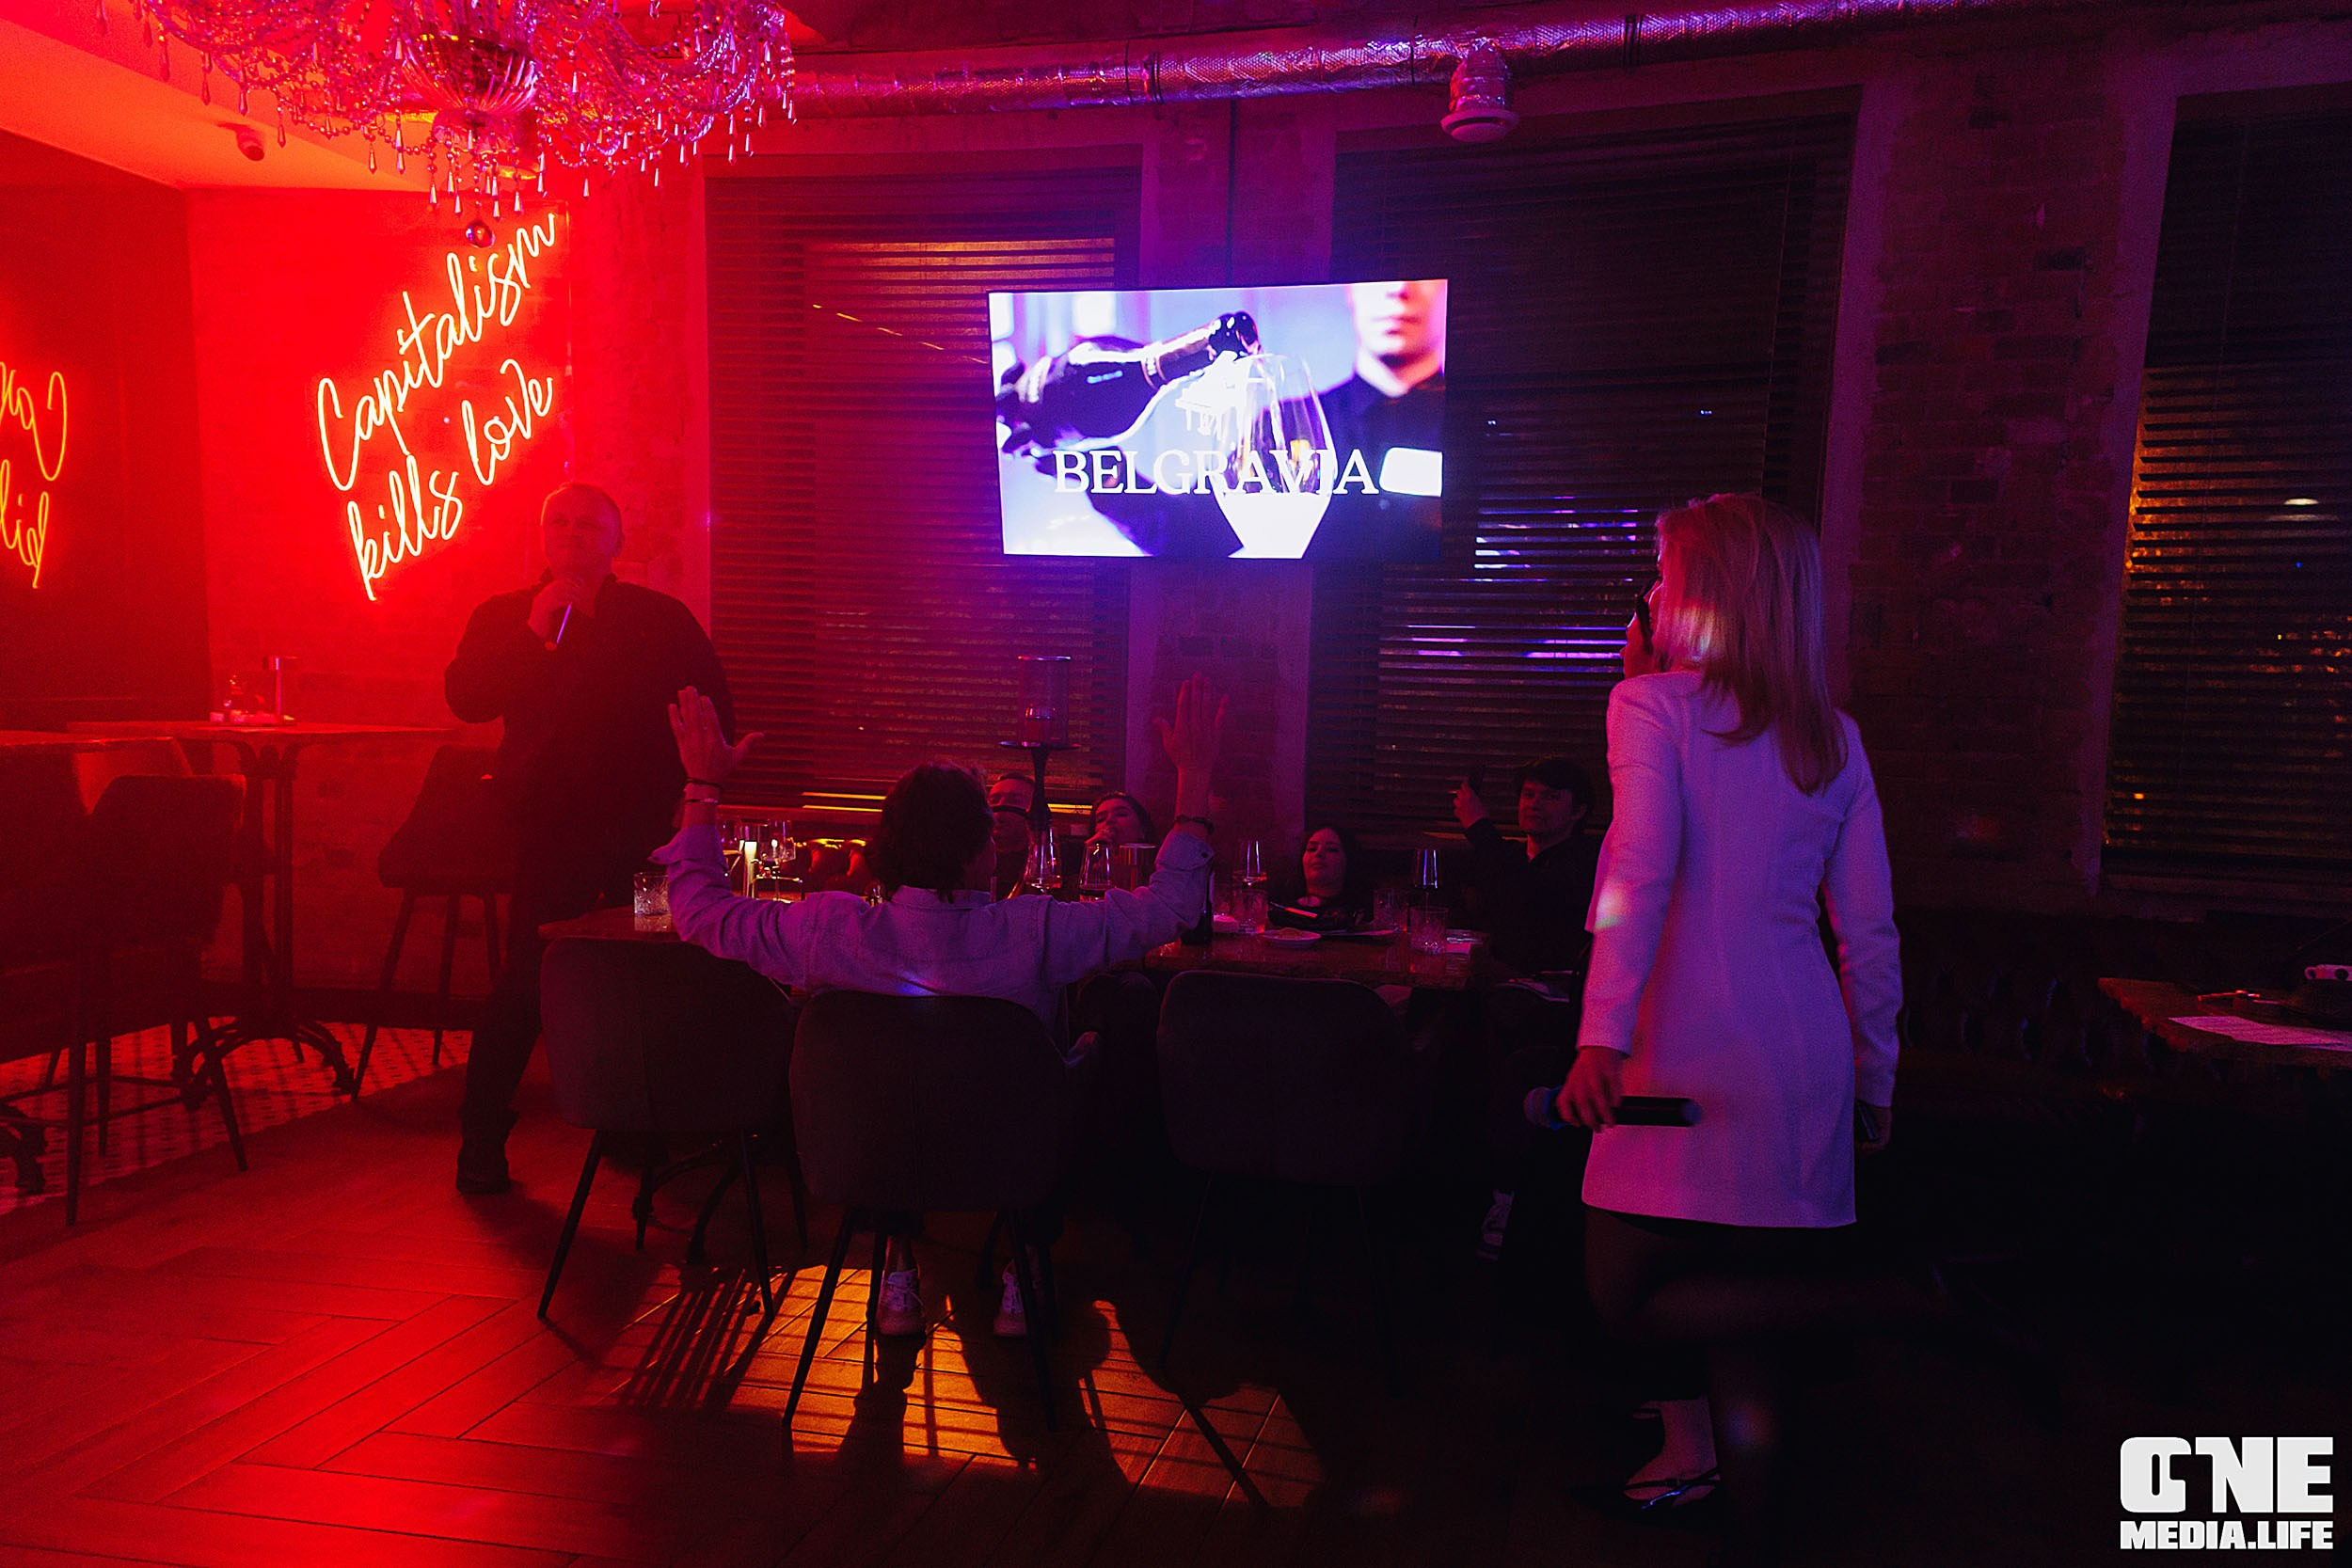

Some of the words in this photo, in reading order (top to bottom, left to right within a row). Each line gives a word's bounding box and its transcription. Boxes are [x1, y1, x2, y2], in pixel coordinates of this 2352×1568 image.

[318, 213, 555, 490] Capitalism
[1053, 448, 1379, 495] BELGRAVIA
[347, 454, 464, 601] kills
[461, 358, 554, 485] love
